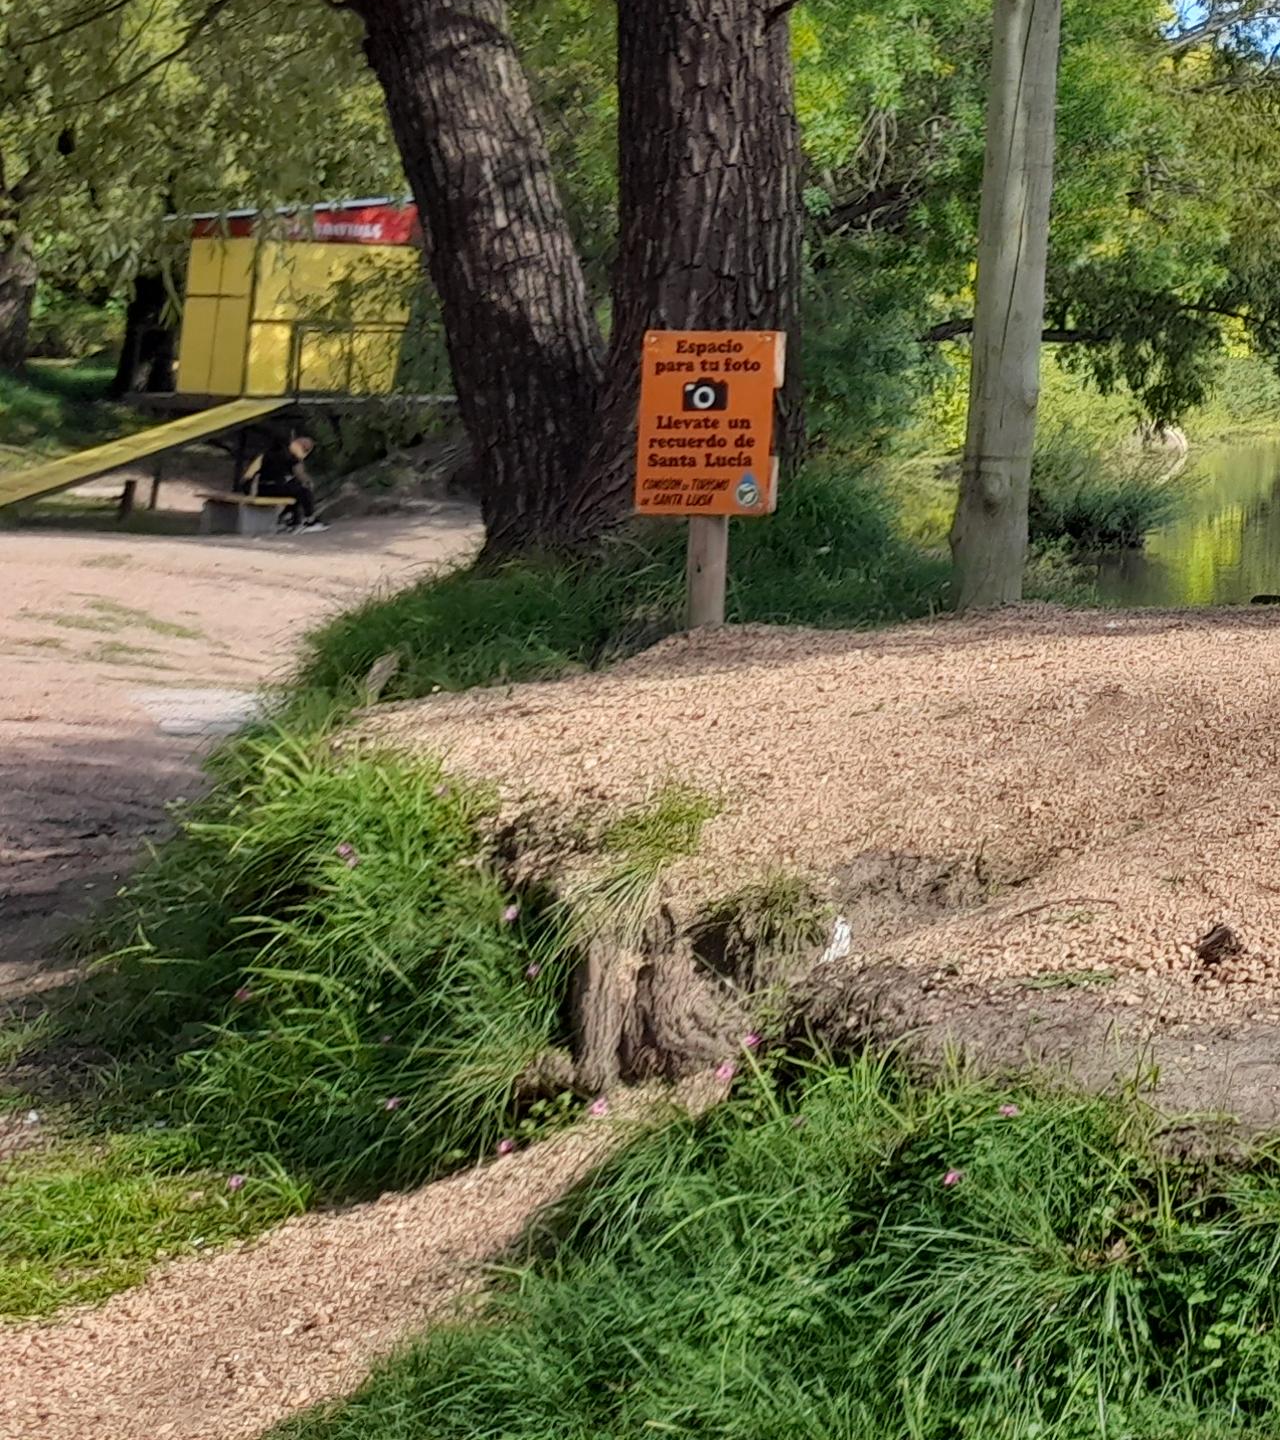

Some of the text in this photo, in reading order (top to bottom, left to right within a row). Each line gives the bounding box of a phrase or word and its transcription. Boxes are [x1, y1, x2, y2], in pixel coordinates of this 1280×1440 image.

[676, 339, 743, 356] Espacio
[655, 358, 761, 375] para tu foto
[656, 415, 751, 430] Llevate un
[648, 434, 755, 448] recuerdo de
[648, 451, 752, 468] Santa Lucía
